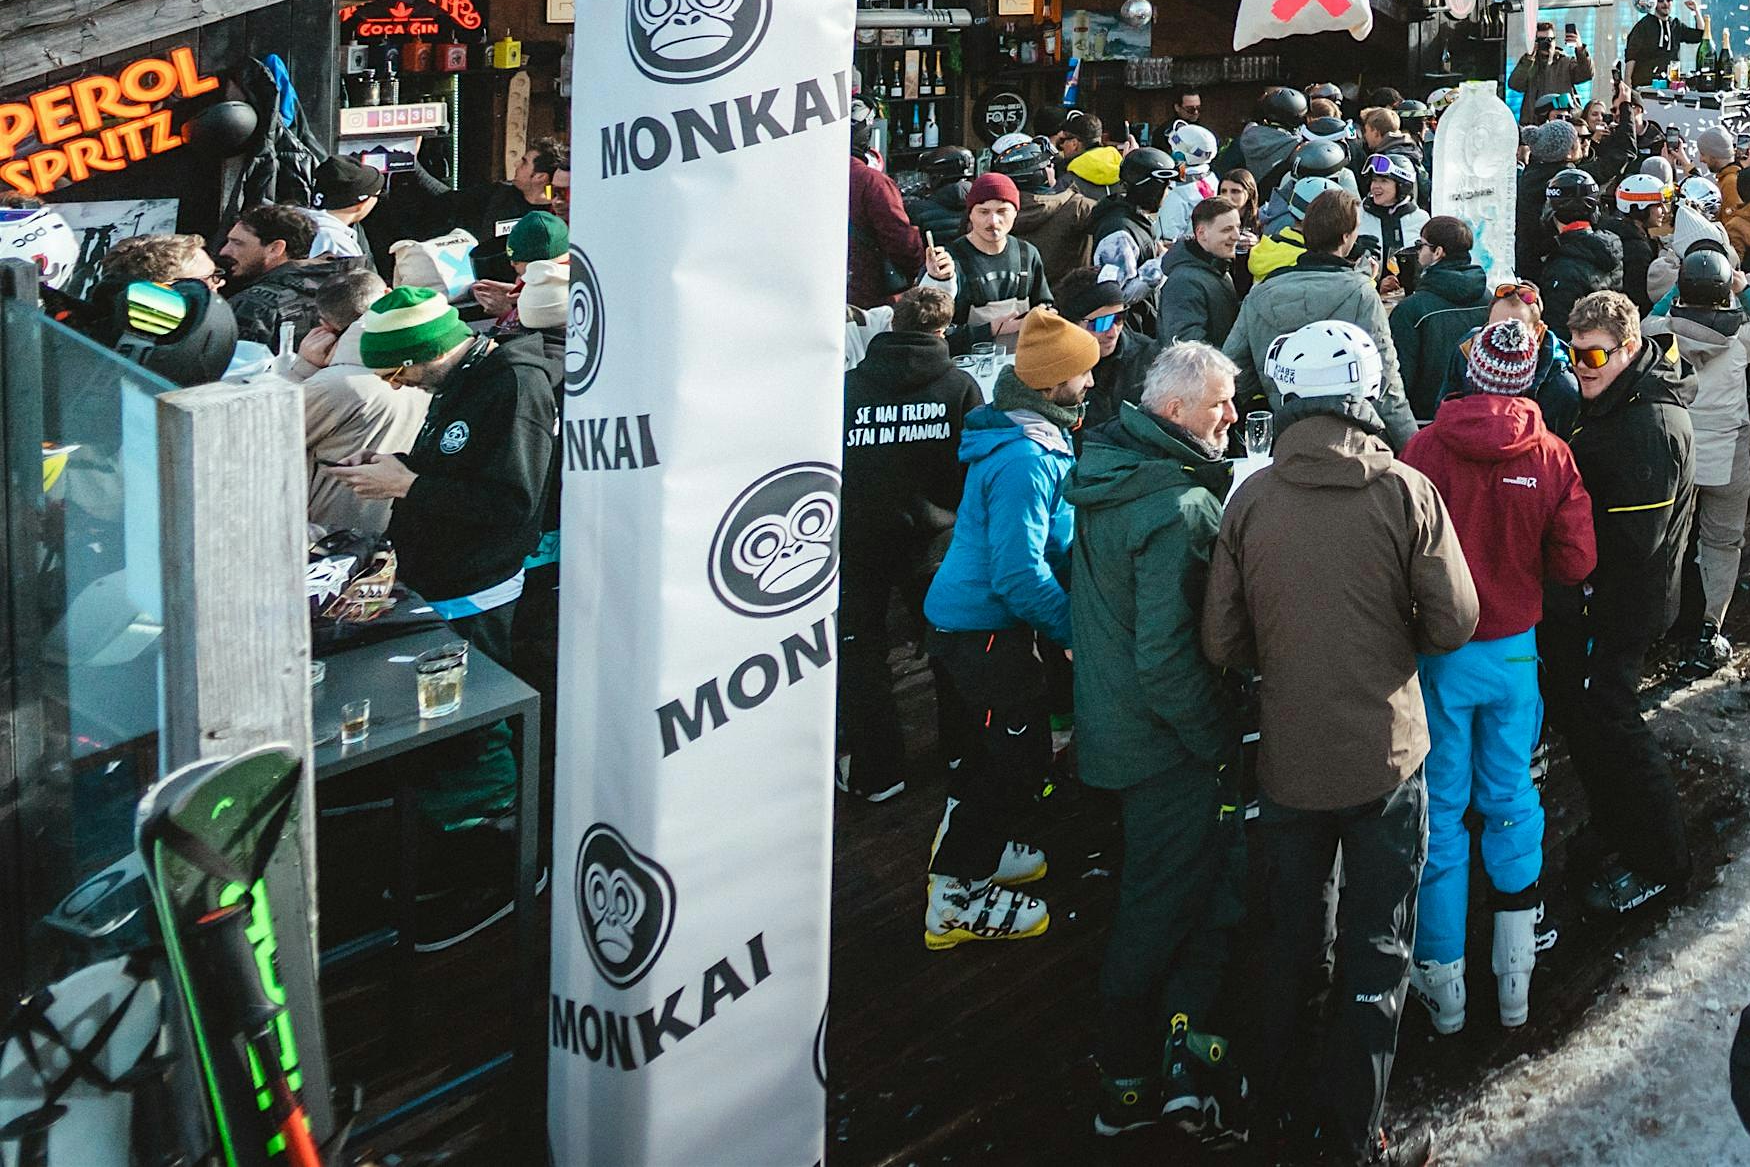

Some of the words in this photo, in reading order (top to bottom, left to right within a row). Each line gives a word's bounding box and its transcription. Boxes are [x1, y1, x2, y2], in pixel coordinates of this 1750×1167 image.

[359, 22, 405, 37] COCA
[409, 22, 439, 36] GIN
[600, 69, 849, 180] MONKAI
[0, 110, 182, 196] SPRITZ
[847, 428, 875, 446] STAI
[879, 426, 895, 444] IN
[899, 422, 950, 442] PIANURA
[855, 406, 871, 424] SE
[875, 405, 898, 423] HAI
[902, 402, 946, 421] FREDDO
[551, 931, 772, 1072] MONKAI
